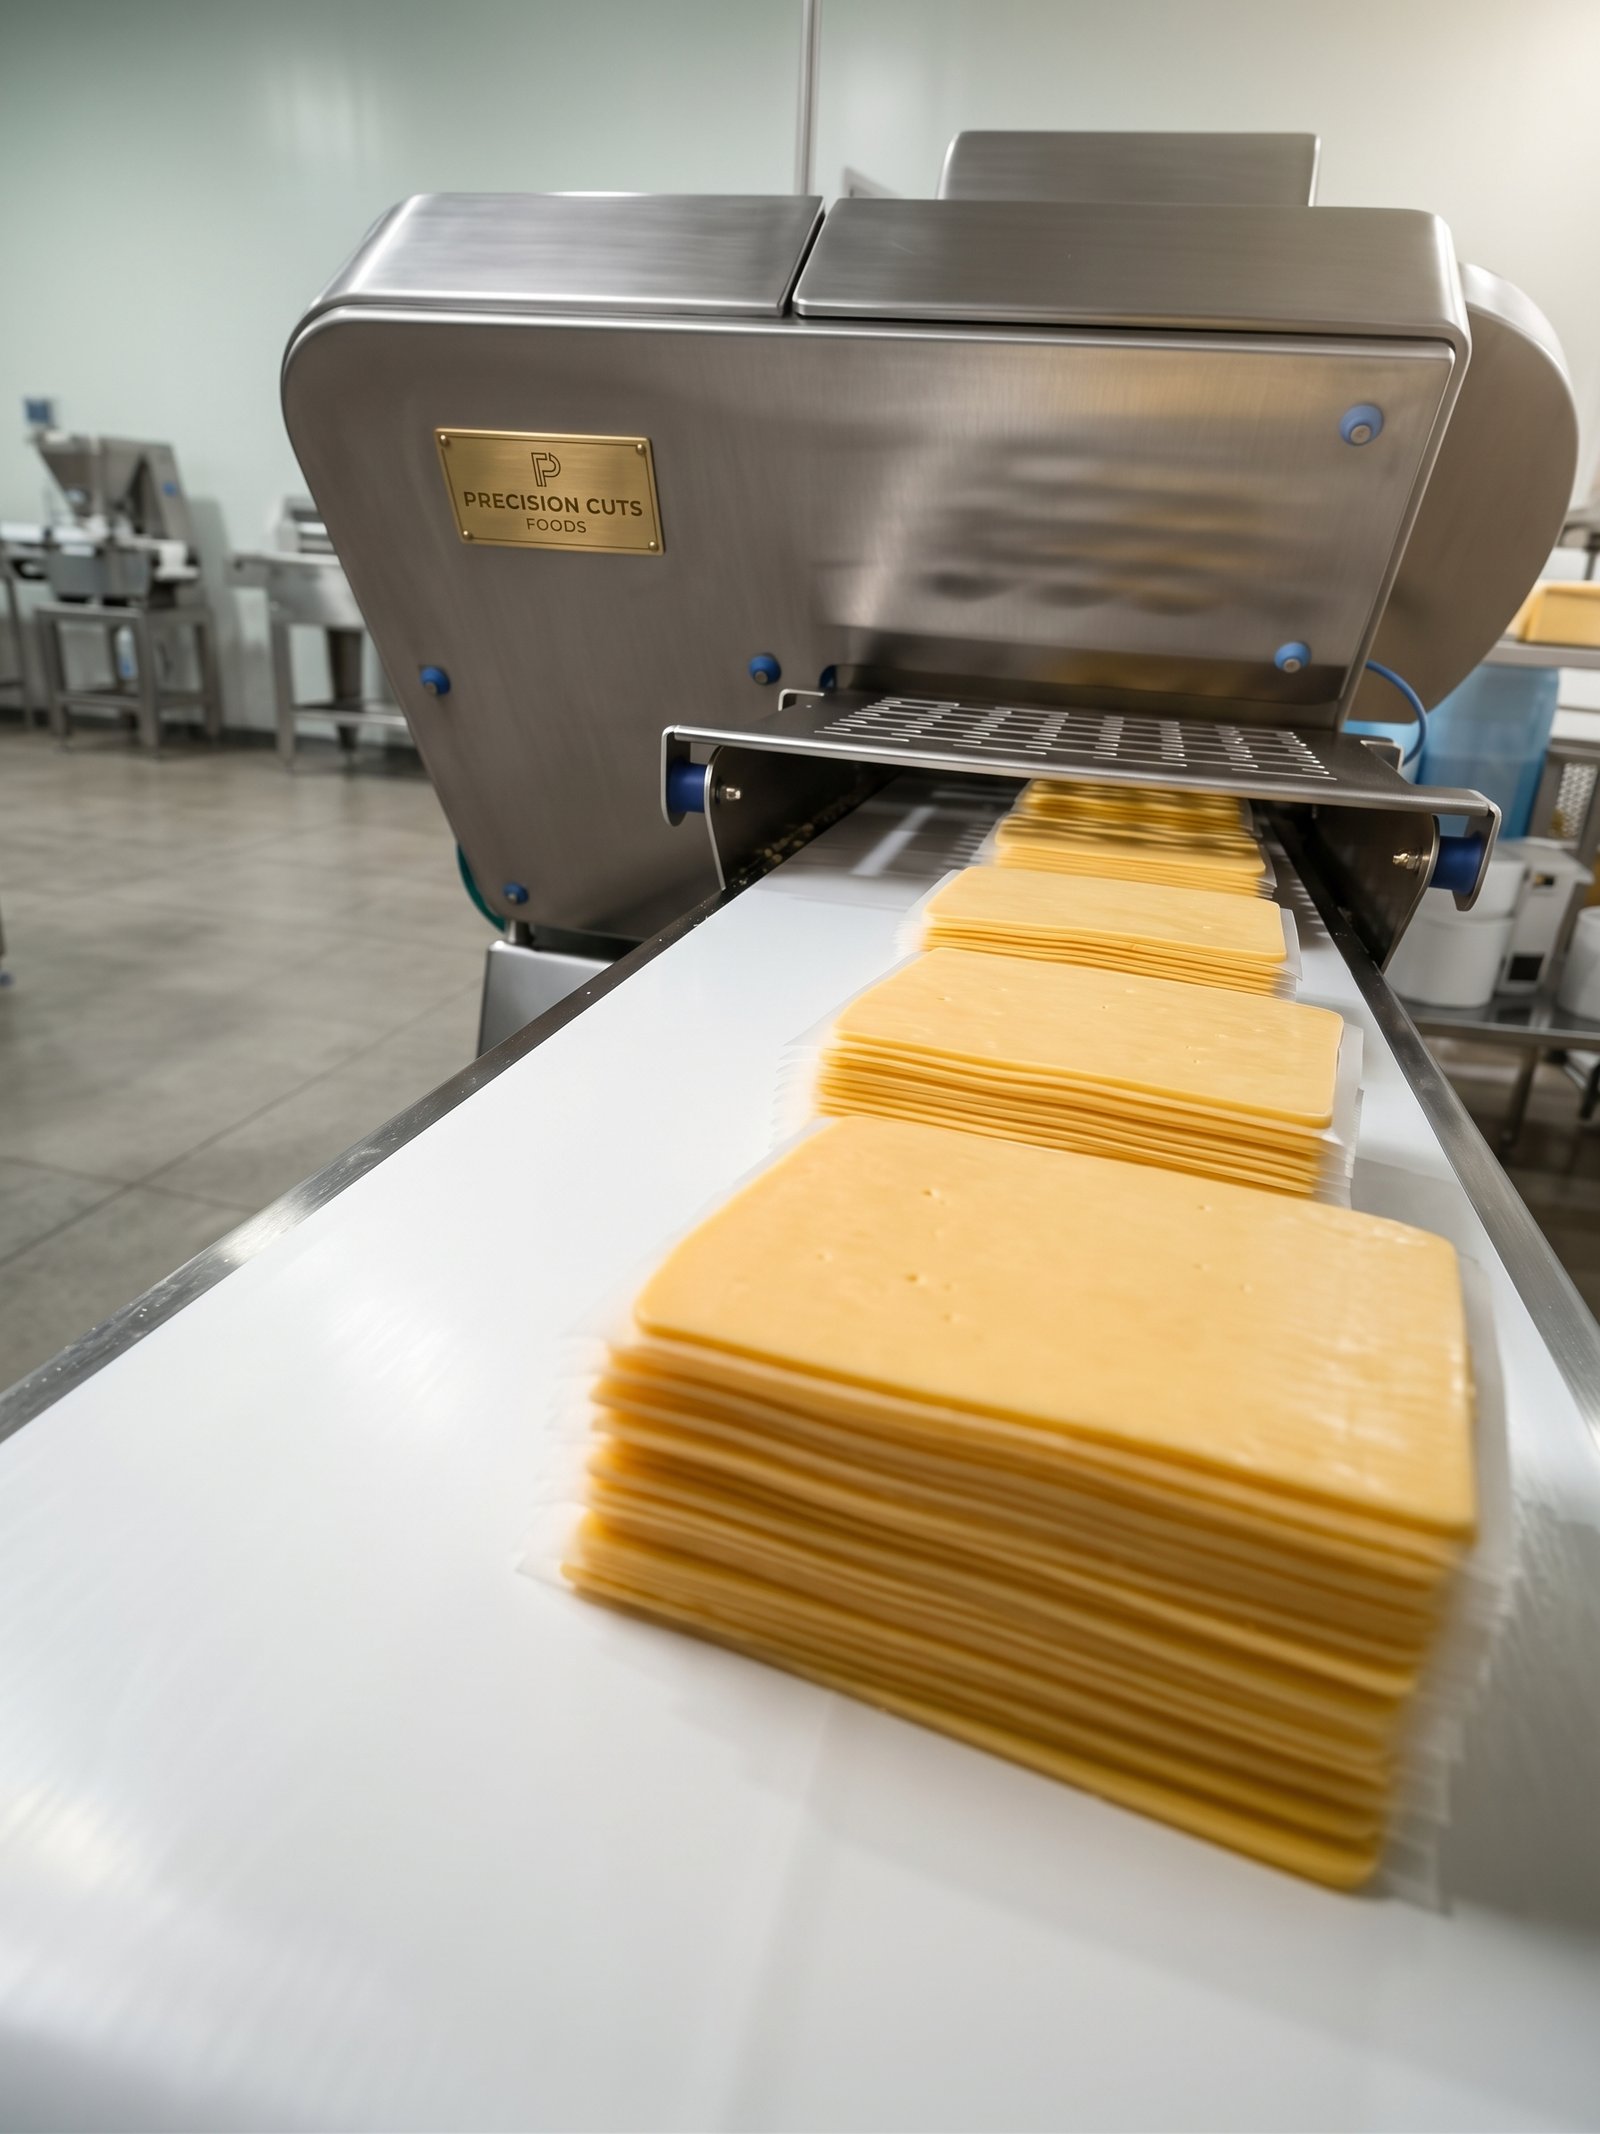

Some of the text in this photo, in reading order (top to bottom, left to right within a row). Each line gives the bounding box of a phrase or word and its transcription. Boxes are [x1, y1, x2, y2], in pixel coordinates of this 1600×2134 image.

[463, 491, 643, 517] PRECISION CUTS
[526, 517, 587, 533] FOODS
